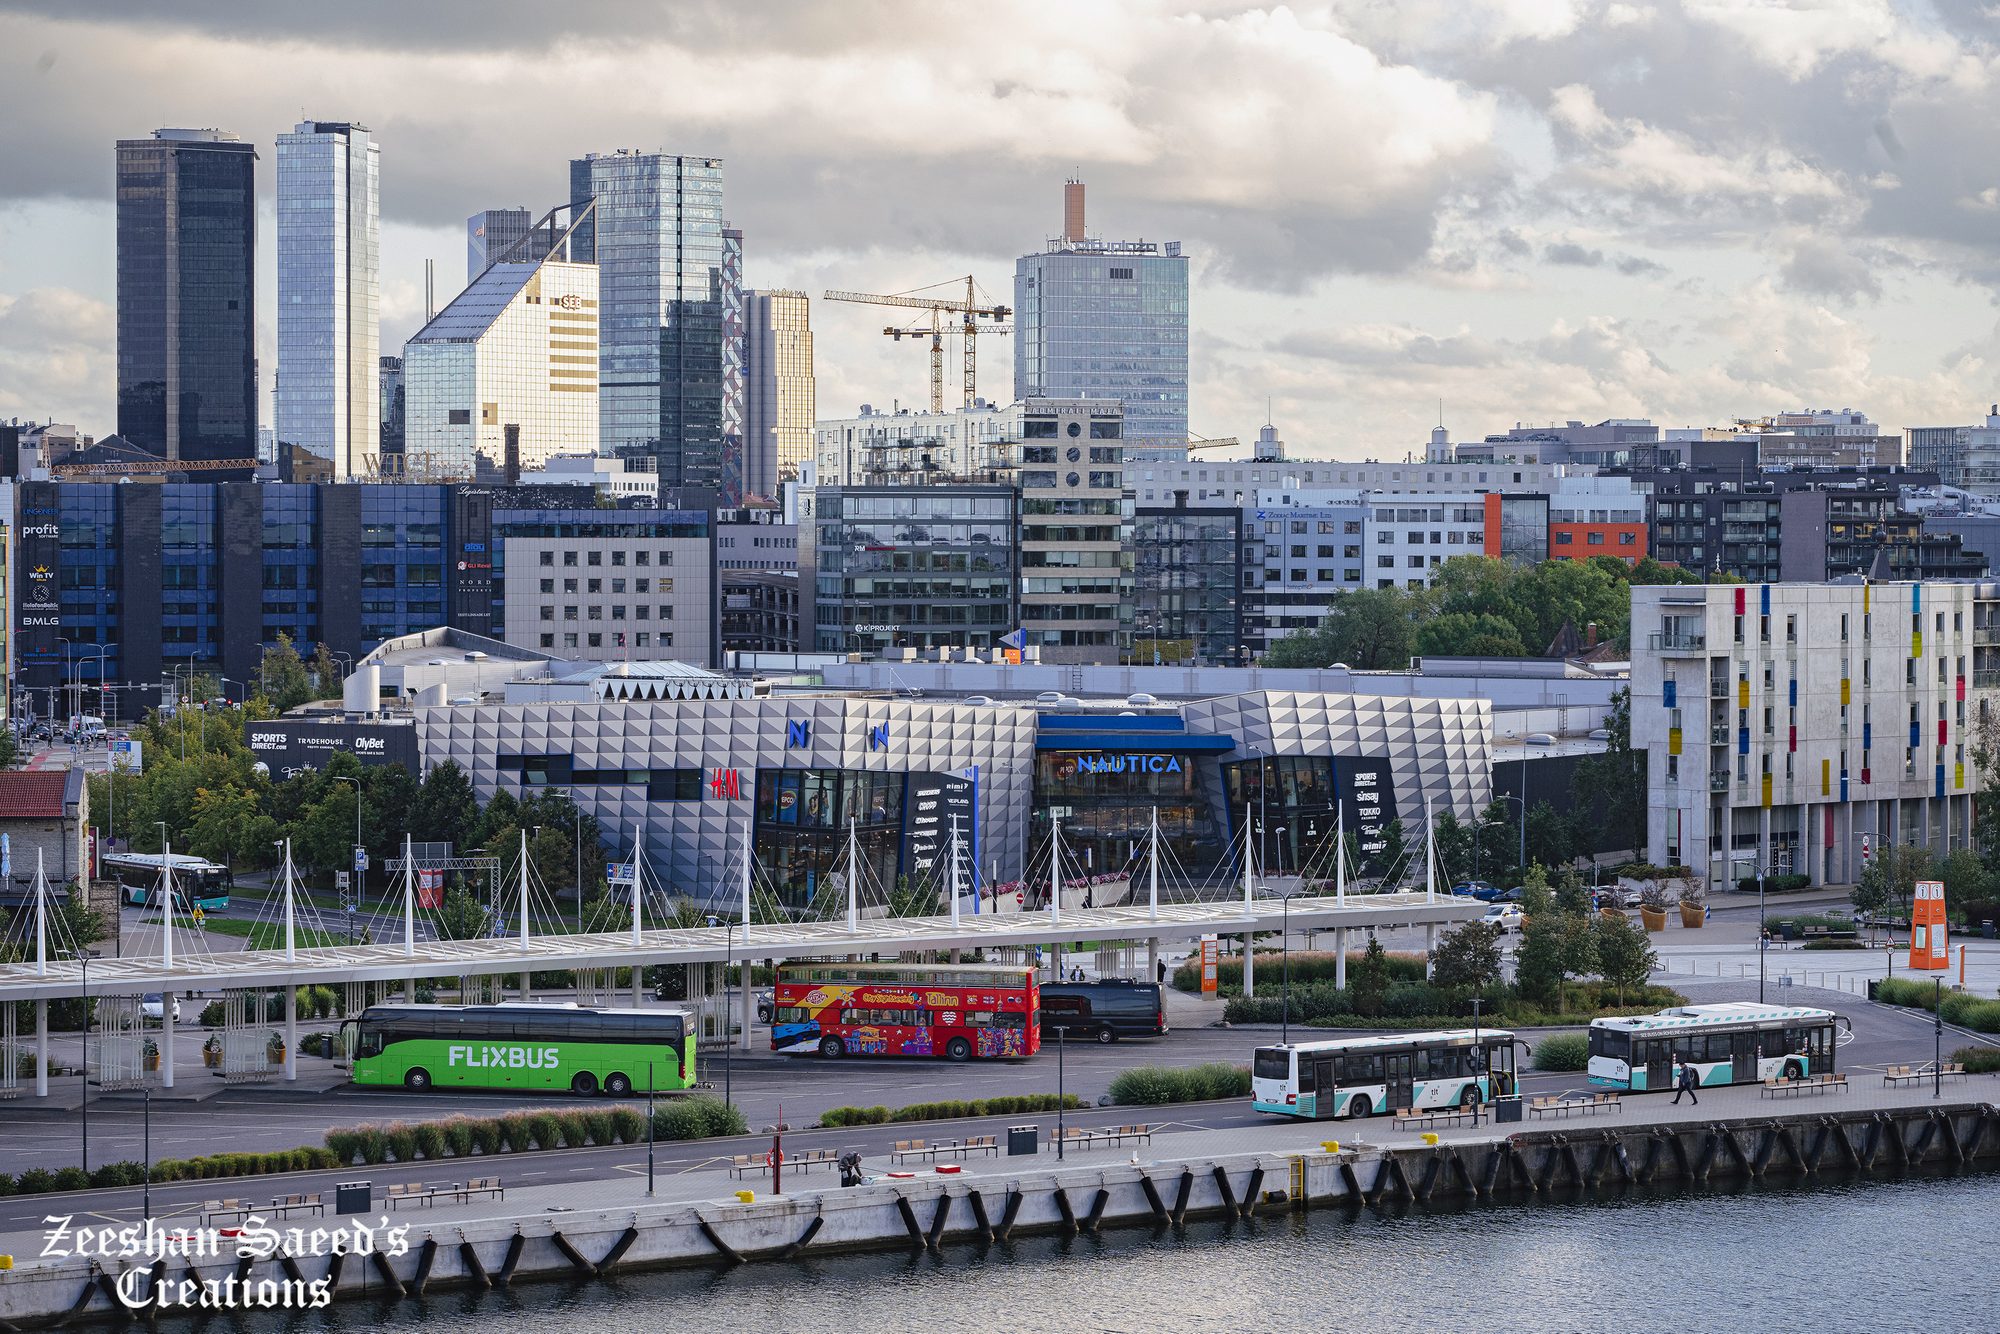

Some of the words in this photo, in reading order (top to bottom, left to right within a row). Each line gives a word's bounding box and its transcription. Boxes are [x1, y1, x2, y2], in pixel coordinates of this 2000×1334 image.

[561, 295, 581, 310] SEB
[23, 523, 59, 538] profit
[23, 617, 59, 625] BMLG
[252, 733, 288, 743] SPORTS
[789, 719, 808, 749] N
[873, 720, 889, 752] N
[355, 737, 385, 750] OlyBet
[1077, 755, 1182, 773] NAUTICA
[1355, 772, 1377, 781] SPORTS
[1356, 791, 1379, 803] sinsay
[1359, 807, 1381, 816] TAKKO
[1362, 841, 1382, 851] Rimi
[925, 991, 959, 1007] Tallinn
